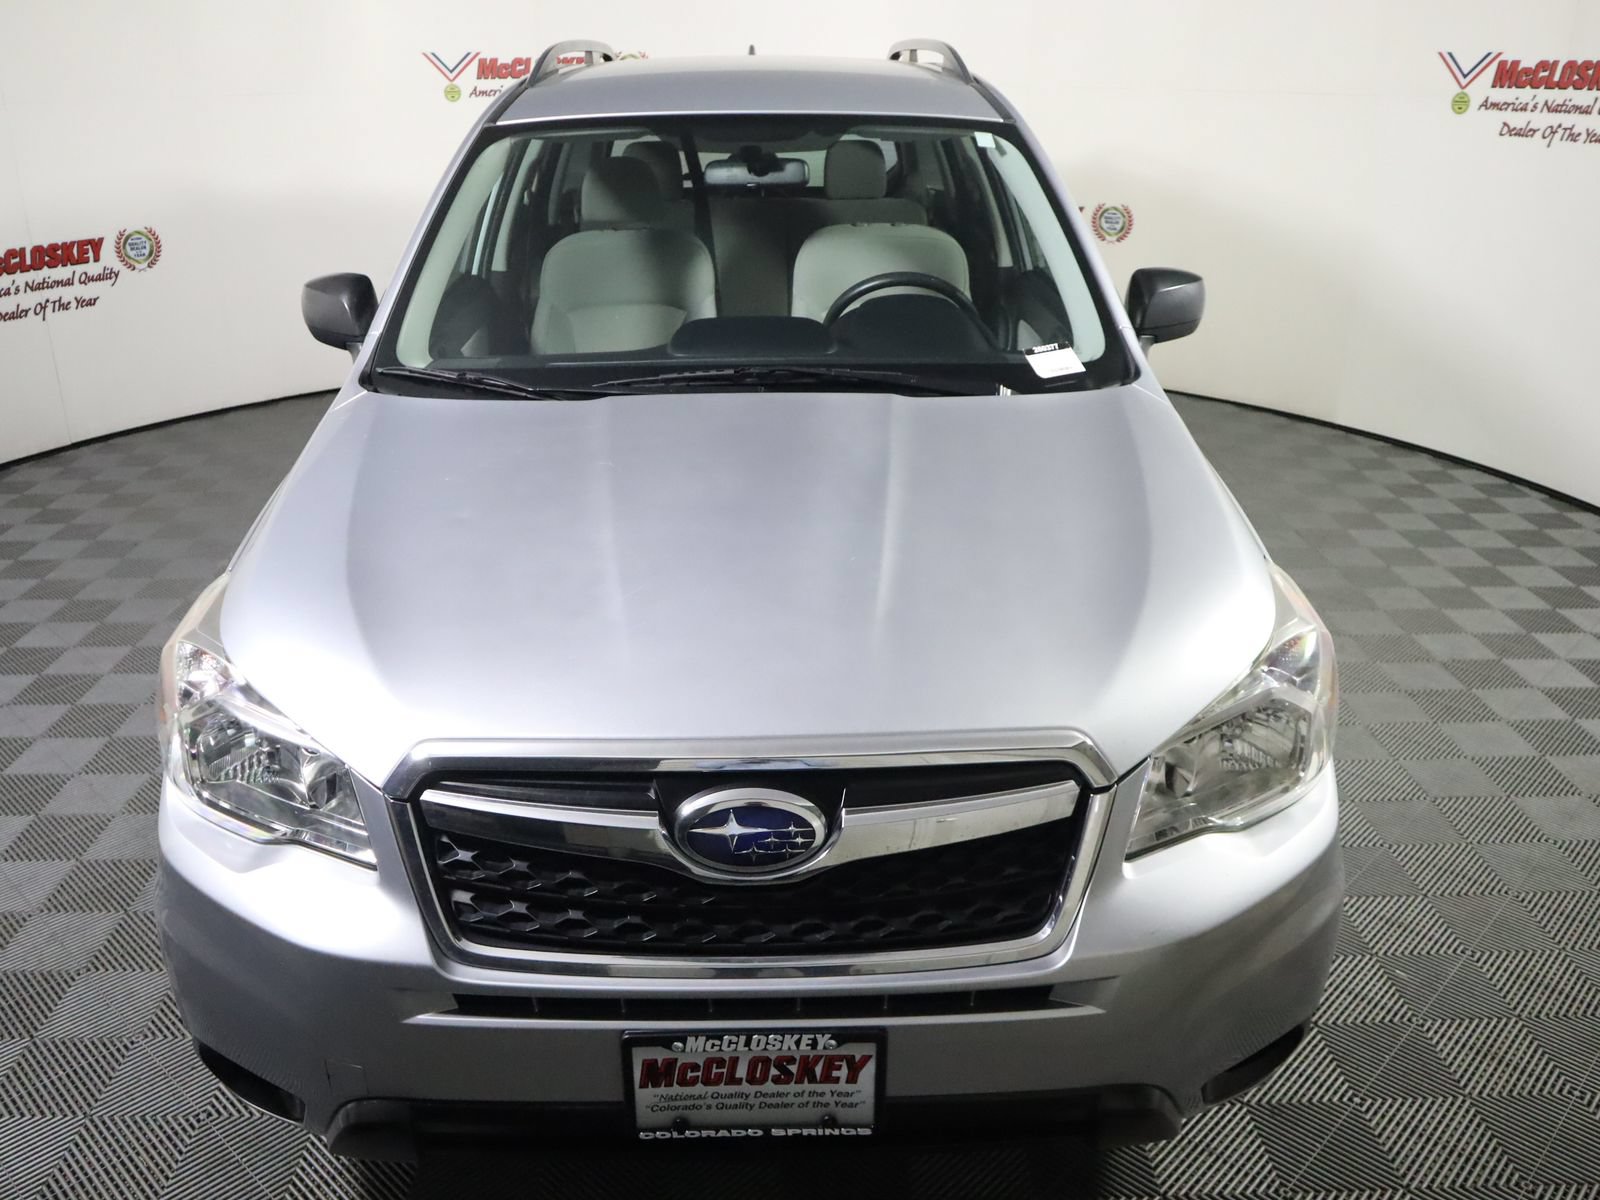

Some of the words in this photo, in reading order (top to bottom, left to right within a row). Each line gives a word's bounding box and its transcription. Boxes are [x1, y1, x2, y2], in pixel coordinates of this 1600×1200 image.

[1478, 95, 1538, 113] America's
[1540, 97, 1596, 115] National
[1499, 121, 1540, 138] Dealer
[1542, 123, 1562, 148] Of
[1560, 124, 1581, 143] The
[24, 270, 75, 293] National
[78, 266, 120, 287] Quality
[34, 298, 49, 321] Of
[50, 296, 71, 313] The
[74, 296, 100, 310] Year
[685, 1034, 832, 1053] McCLOSKEY
[639, 1055, 873, 1089] McCLOSKEY
[711, 1091, 752, 1101] Quality
[754, 1090, 791, 1099] Dealer
[793, 1090, 807, 1098] of
[808, 1090, 828, 1098] the
[716, 1101, 756, 1112] Quality
[758, 1101, 795, 1110] Dealer
[798, 1100, 811, 1109] of
[812, 1100, 831, 1109] the
[639, 1129, 764, 1140] COLORADO
[771, 1128, 873, 1137] SPRINGS
